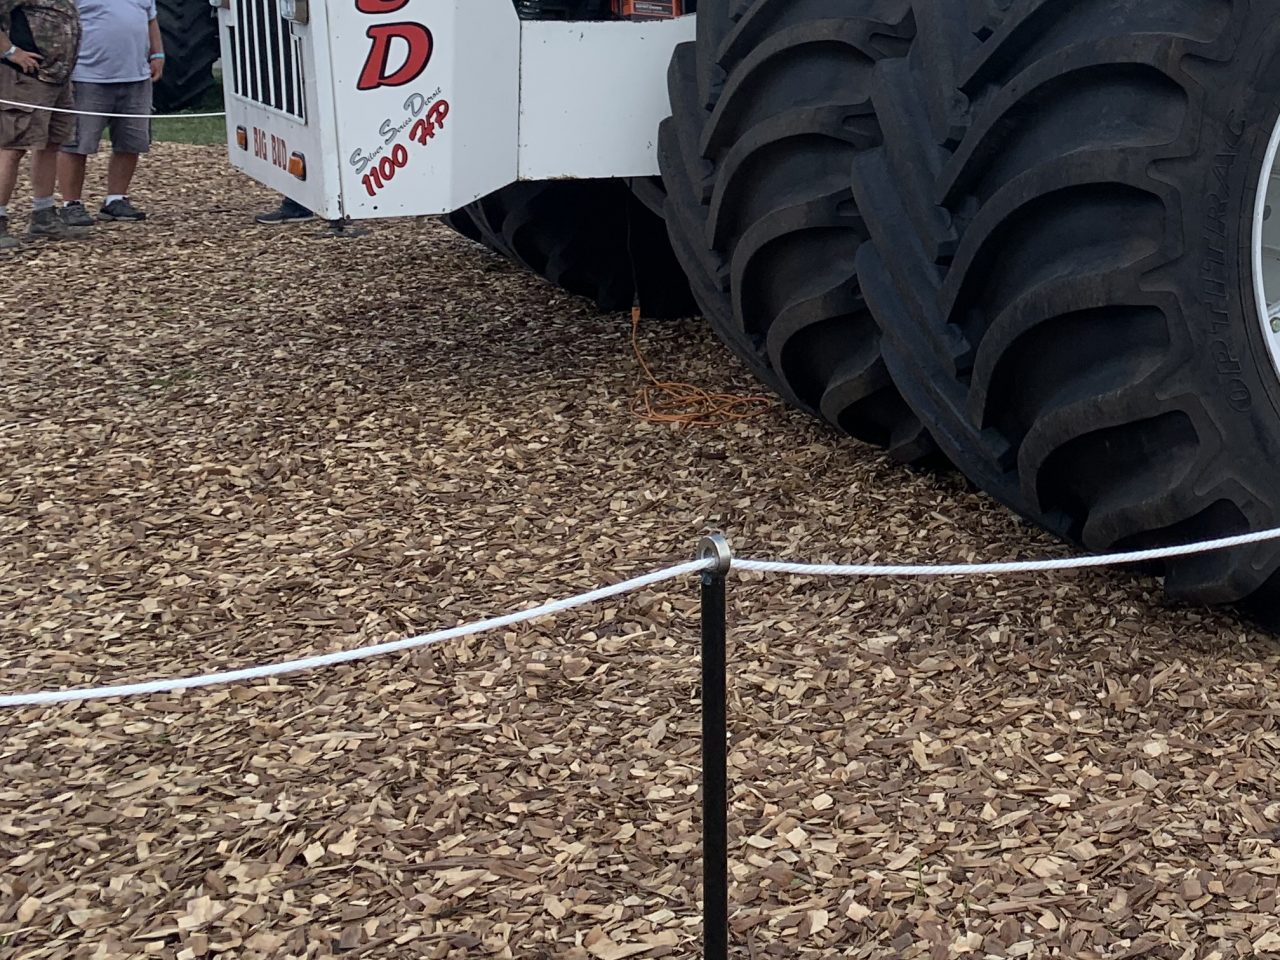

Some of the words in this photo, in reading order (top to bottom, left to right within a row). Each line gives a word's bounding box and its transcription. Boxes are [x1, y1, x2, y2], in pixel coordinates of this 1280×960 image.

[253, 126, 268, 161] BIG
[271, 133, 287, 171] BUD
[349, 145, 384, 175] Silver
[378, 118, 412, 146] Series
[403, 86, 442, 118] Detroit
[361, 143, 409, 197] 1100
[408, 99, 450, 146] HP
